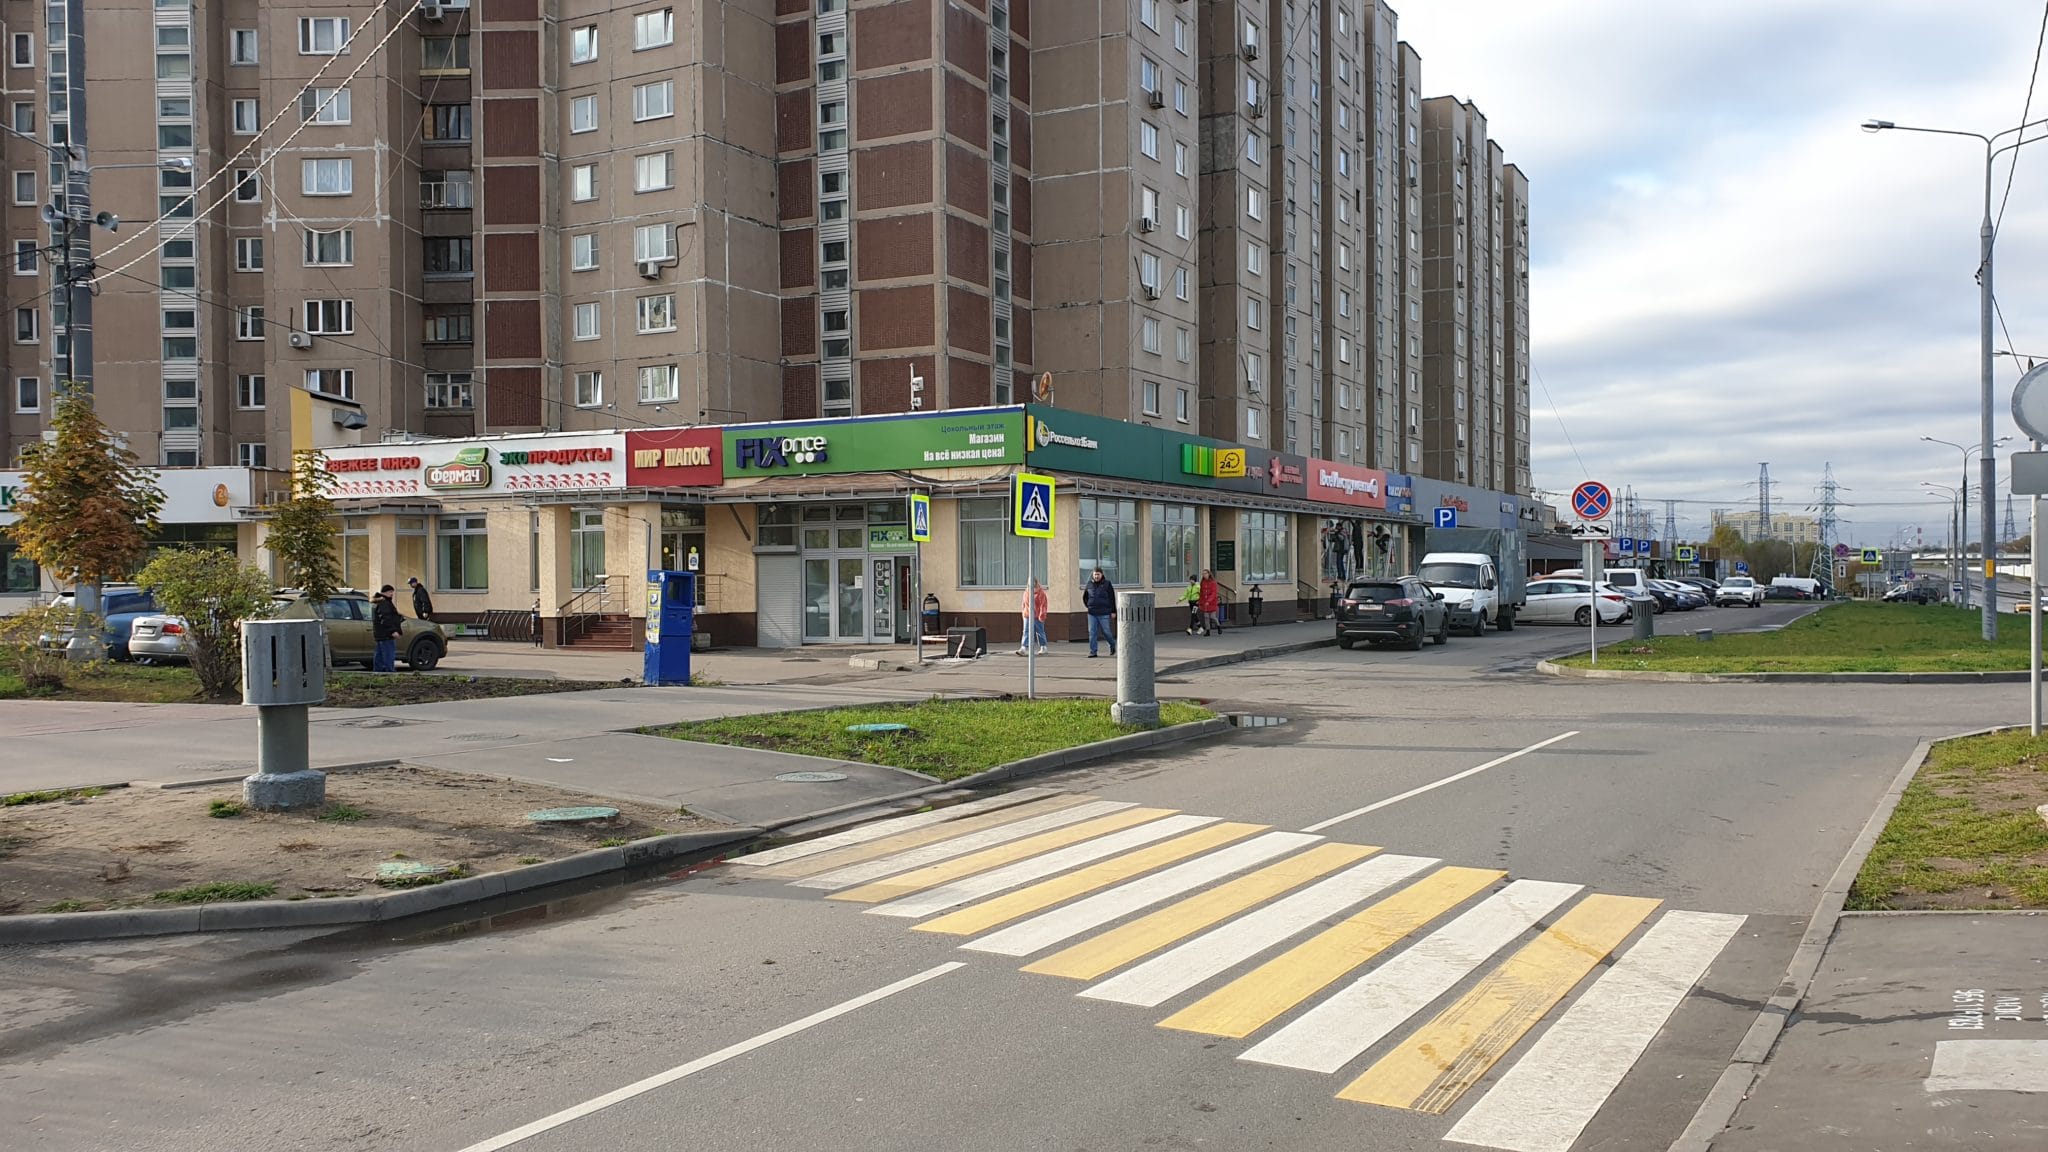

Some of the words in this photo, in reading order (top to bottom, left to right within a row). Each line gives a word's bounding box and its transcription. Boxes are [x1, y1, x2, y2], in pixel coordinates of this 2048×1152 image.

[987, 423, 1005, 431] этаж
[969, 433, 1005, 445] Магазин
[500, 448, 614, 466] ЭКОПРОДУКТЫ
[634, 449, 662, 468] МИР
[664, 447, 712, 467] ШАПОК
[736, 437, 788, 468] FIX
[782, 436, 827, 456] price
[924, 451, 935, 462] На
[935, 449, 949, 461] всё
[950, 448, 980, 460] низкая
[982, 446, 1005, 460] цена!
[325, 458, 378, 473] СВЕЖЕЕ
[381, 456, 421, 470] МЯСО
[1220, 461, 1231, 469] 24
[431, 468, 480, 484] Фермач
[871, 531, 888, 541] FIX
[875, 562, 887, 597] price
